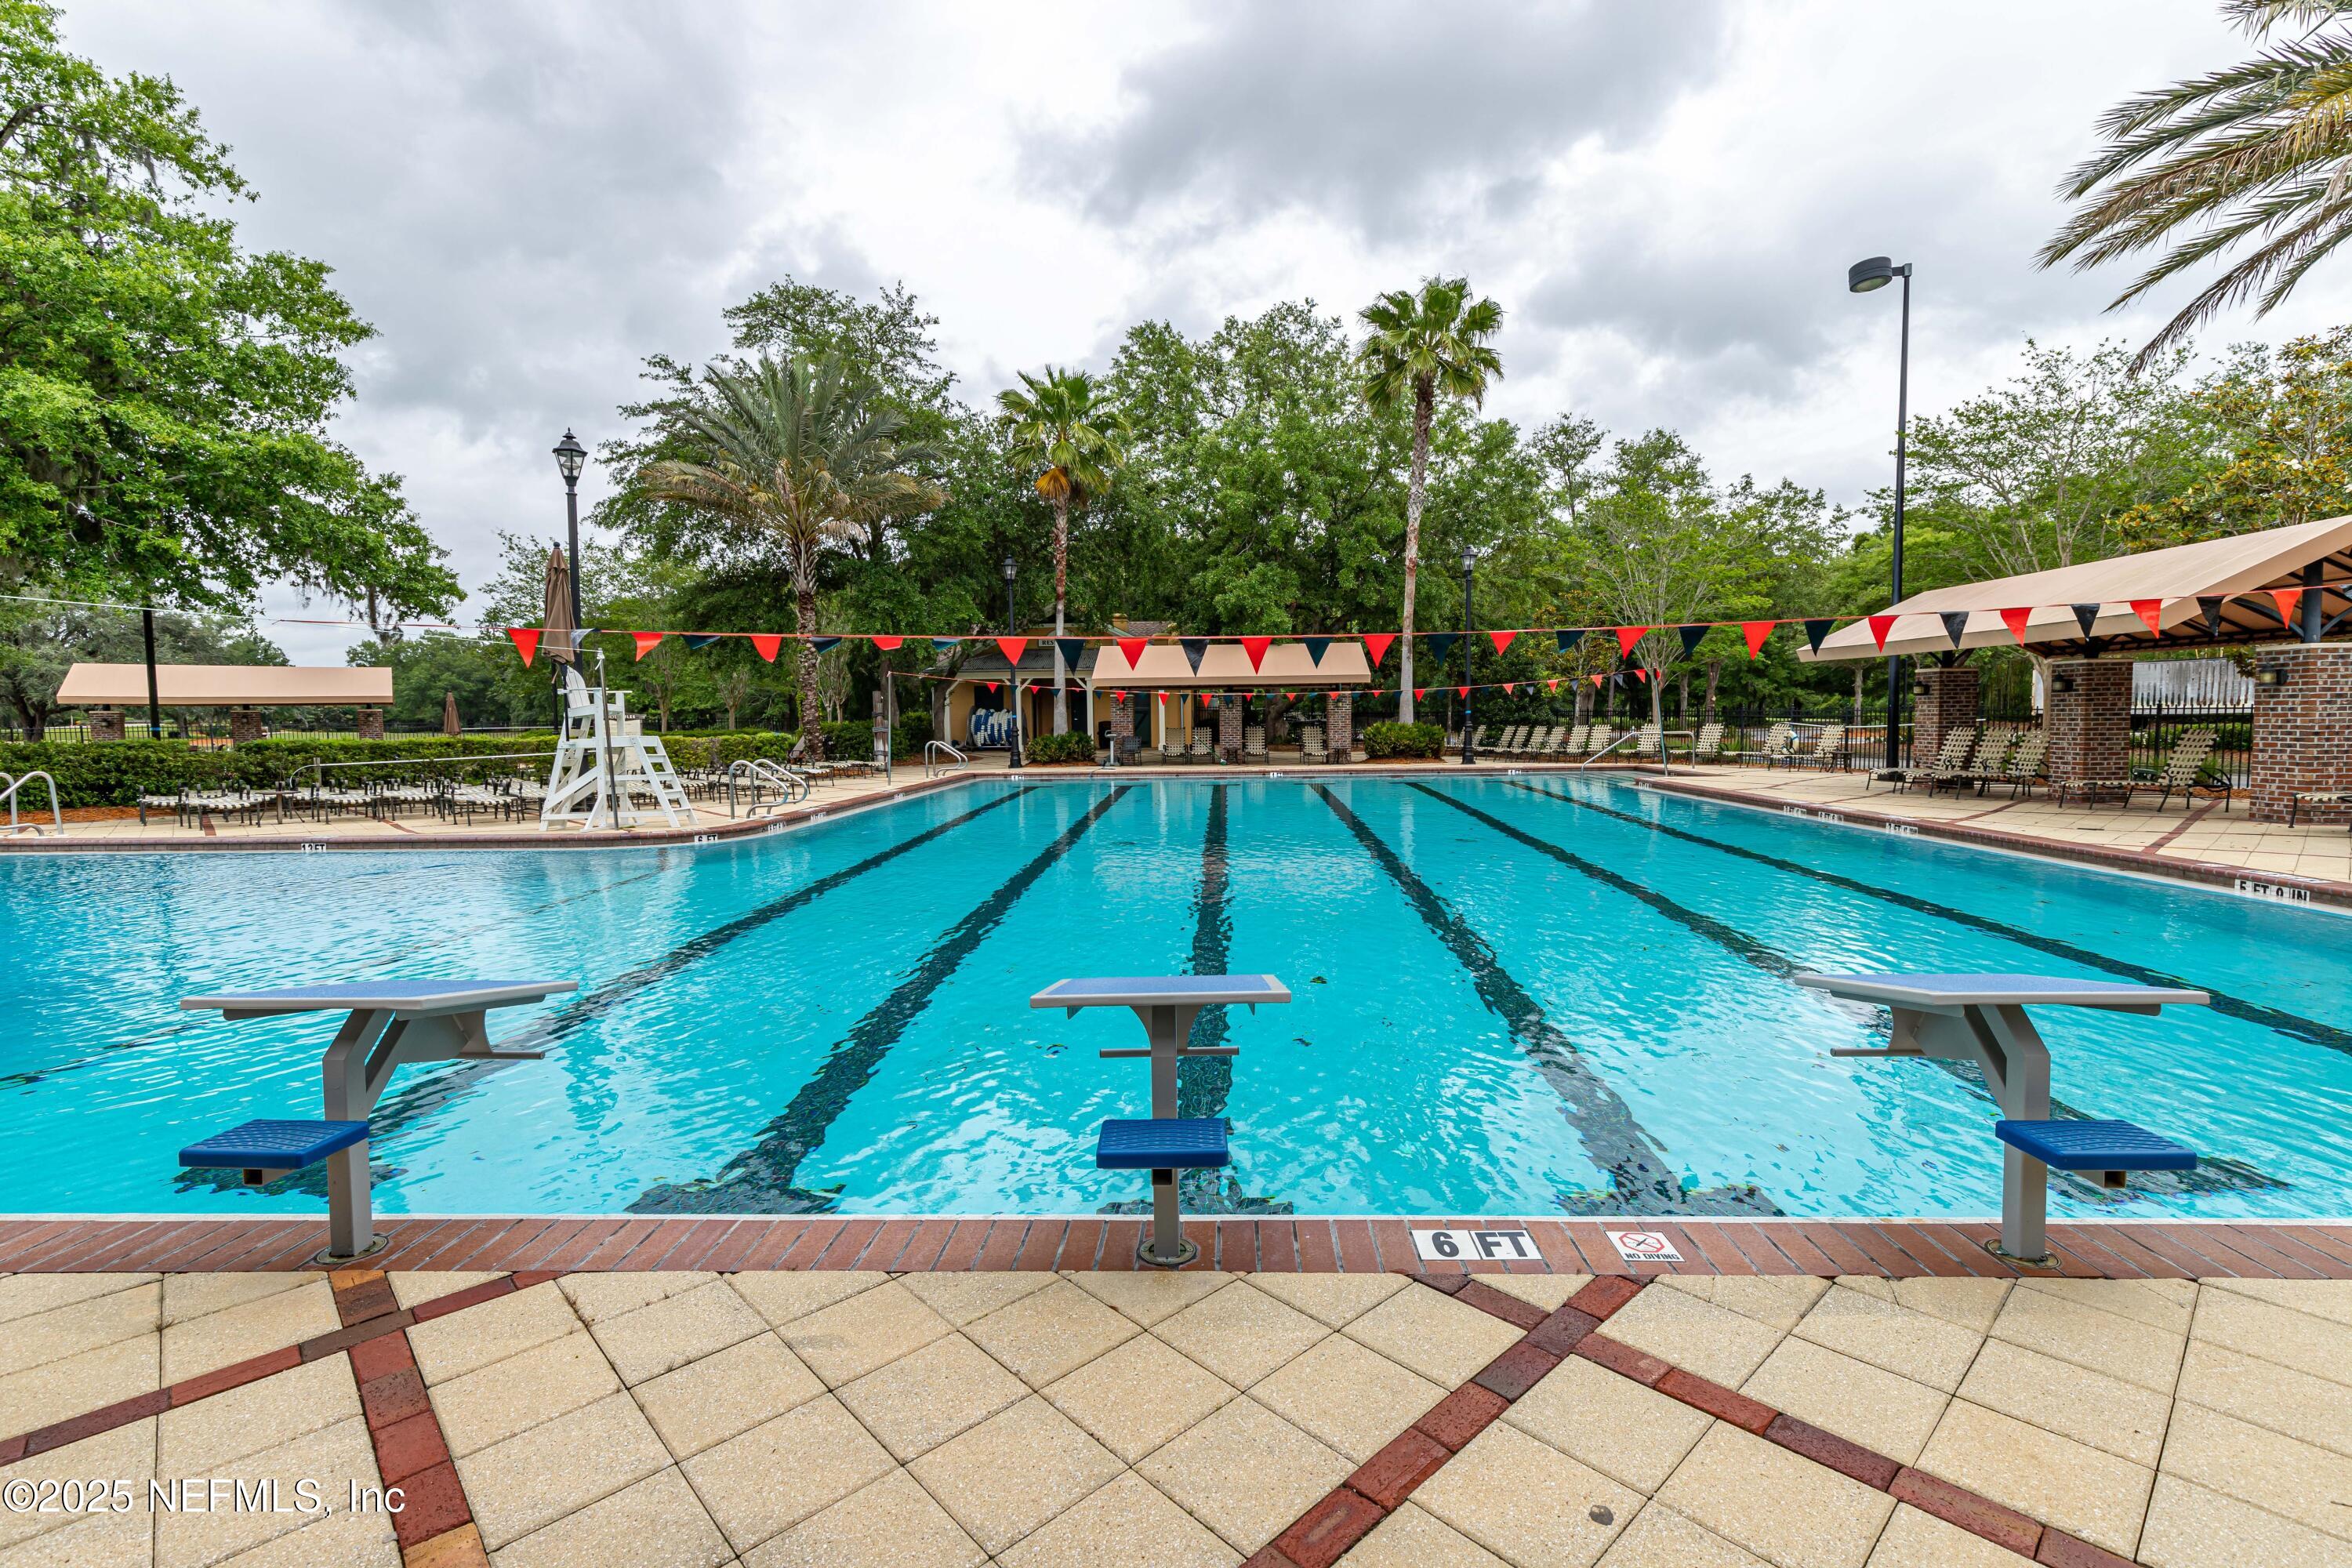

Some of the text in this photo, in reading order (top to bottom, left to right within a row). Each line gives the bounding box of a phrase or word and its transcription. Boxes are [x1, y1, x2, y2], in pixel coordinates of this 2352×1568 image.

[2254, 884, 2269, 895] FT
[2292, 889, 2307, 902] IN
[1432, 1232, 1528, 1258] 6 FT
